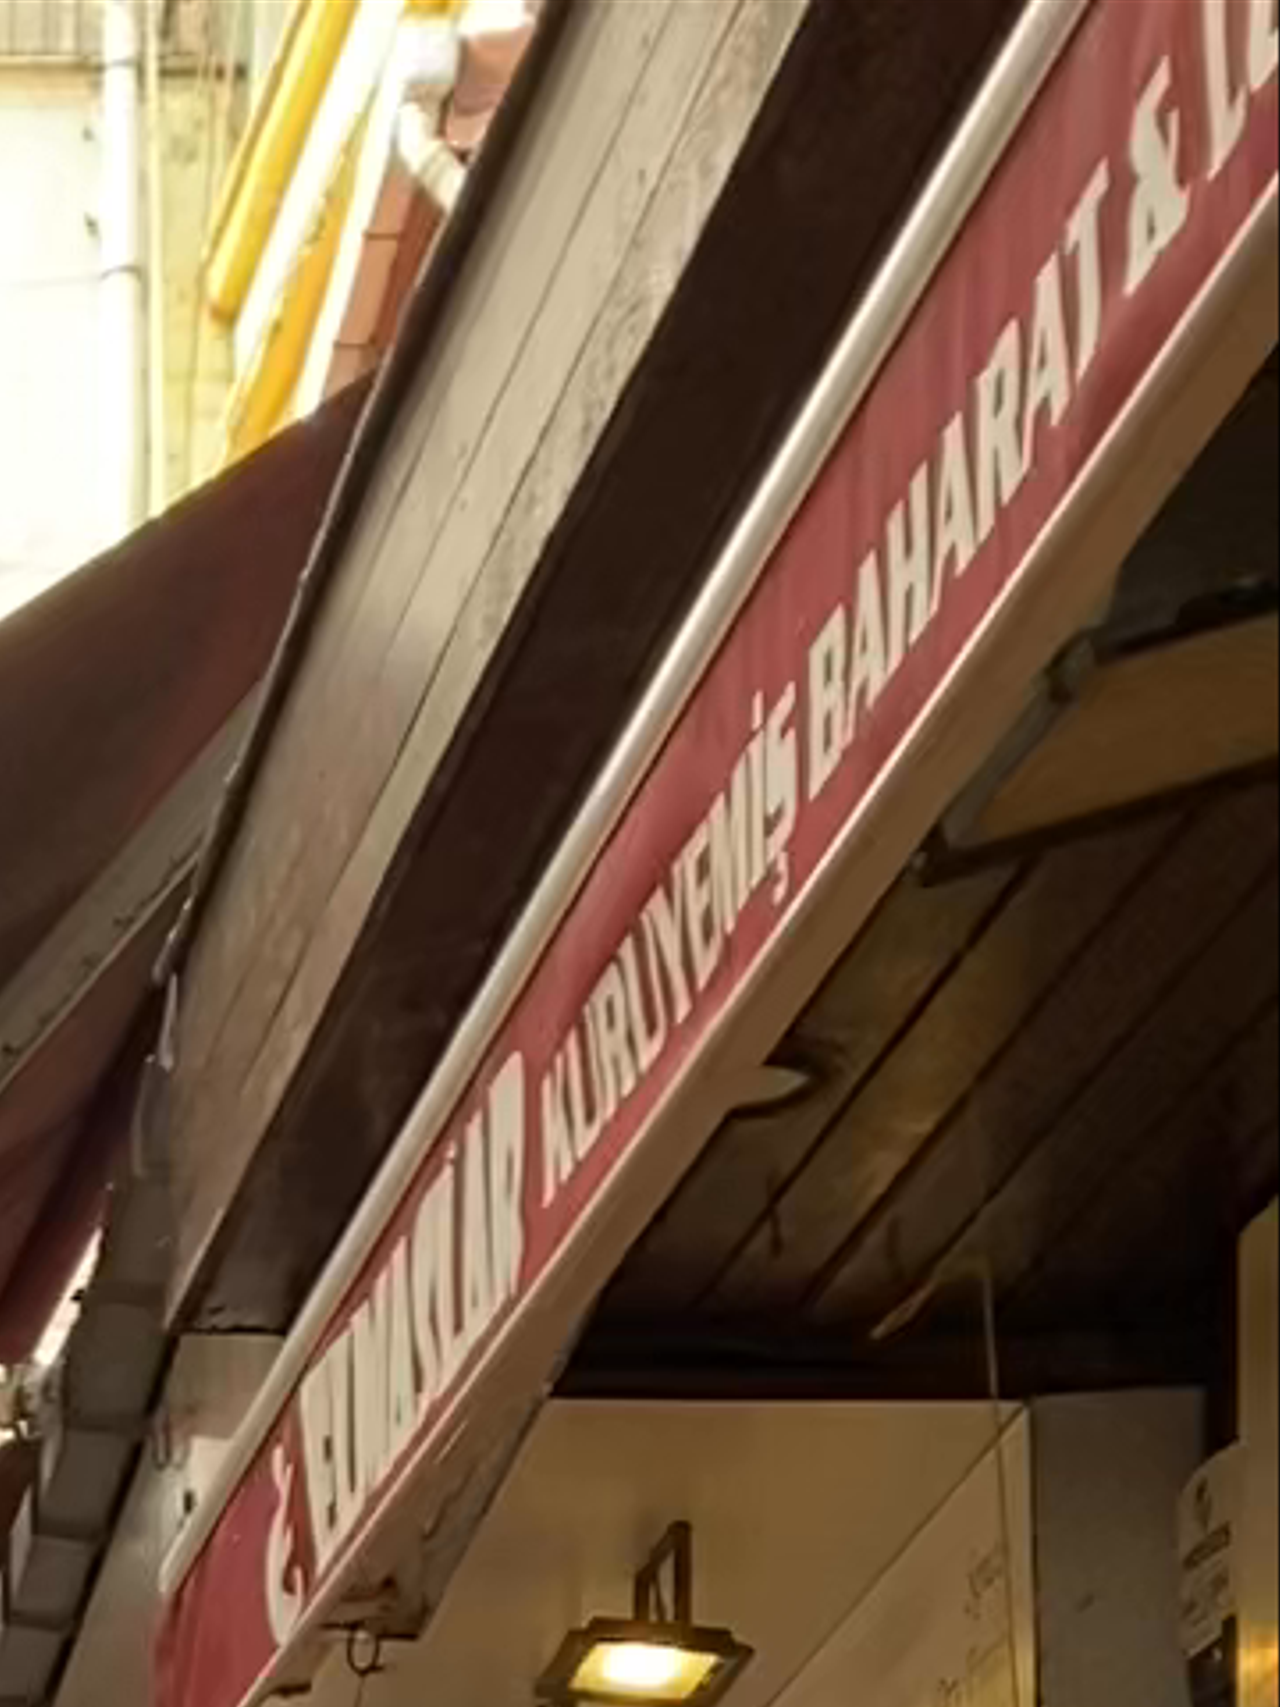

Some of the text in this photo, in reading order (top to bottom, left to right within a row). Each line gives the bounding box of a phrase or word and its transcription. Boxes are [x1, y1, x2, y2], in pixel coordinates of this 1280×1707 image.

[541, 680, 798, 1210] KURUYEMİŞ
[808, 157, 1108, 802] BAHARAT
[1124, 55, 1190, 298] &
